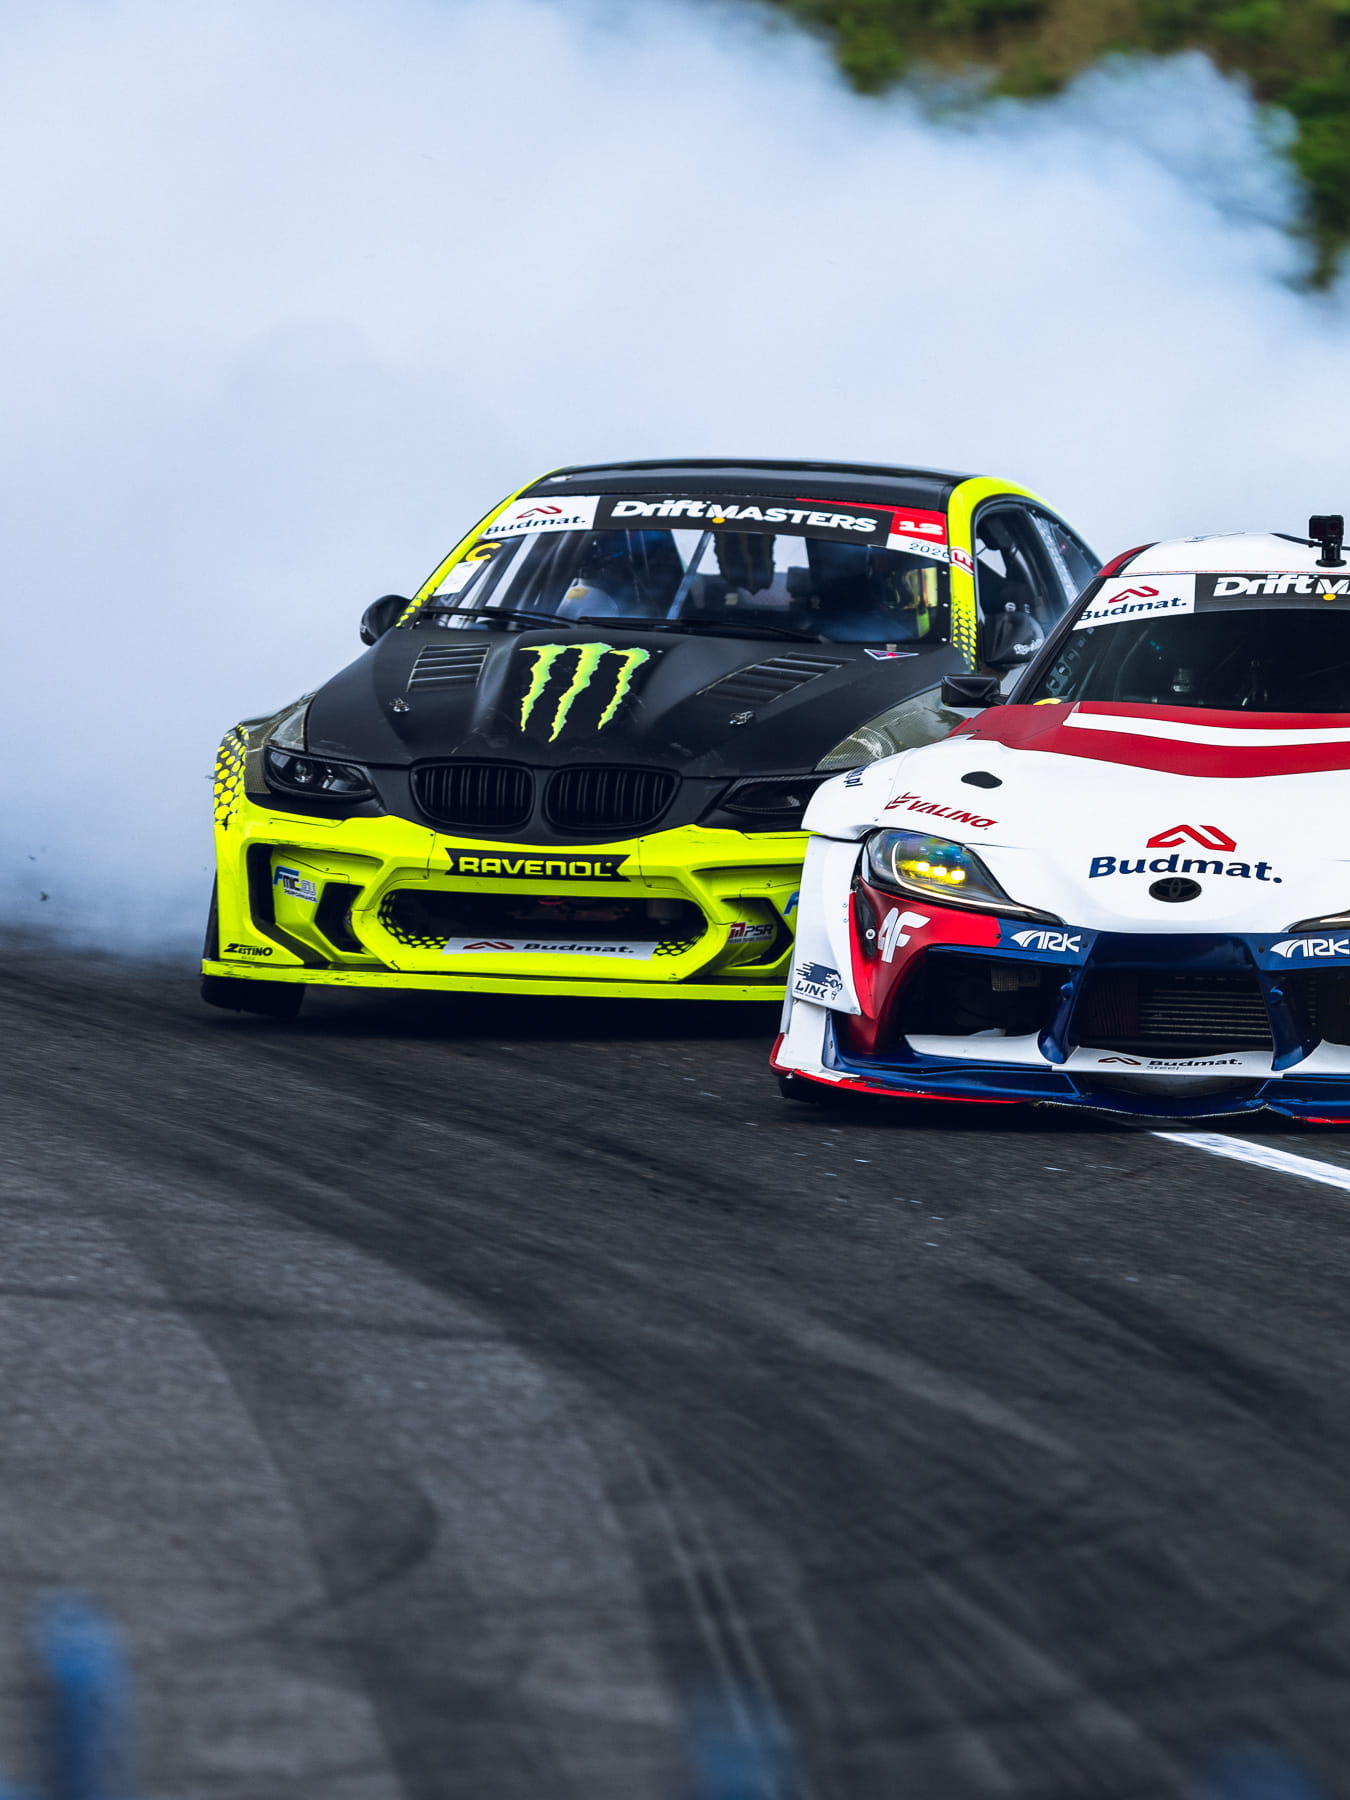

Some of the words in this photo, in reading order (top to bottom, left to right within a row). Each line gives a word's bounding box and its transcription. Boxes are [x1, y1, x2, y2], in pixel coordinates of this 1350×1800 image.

[906, 800, 999, 829] VALINO
[459, 856, 612, 877] RAVENOL
[1089, 854, 1283, 884] Budmat.
[877, 907, 932, 964] 4F
[1010, 929, 1082, 953] ARK
[223, 943, 273, 957] ZESTINO
[523, 943, 635, 954] Budmat.
[1270, 938, 1350, 959] ARK
[794, 980, 828, 999] LINK
[1147, 1058, 1243, 1067] Budmat.
